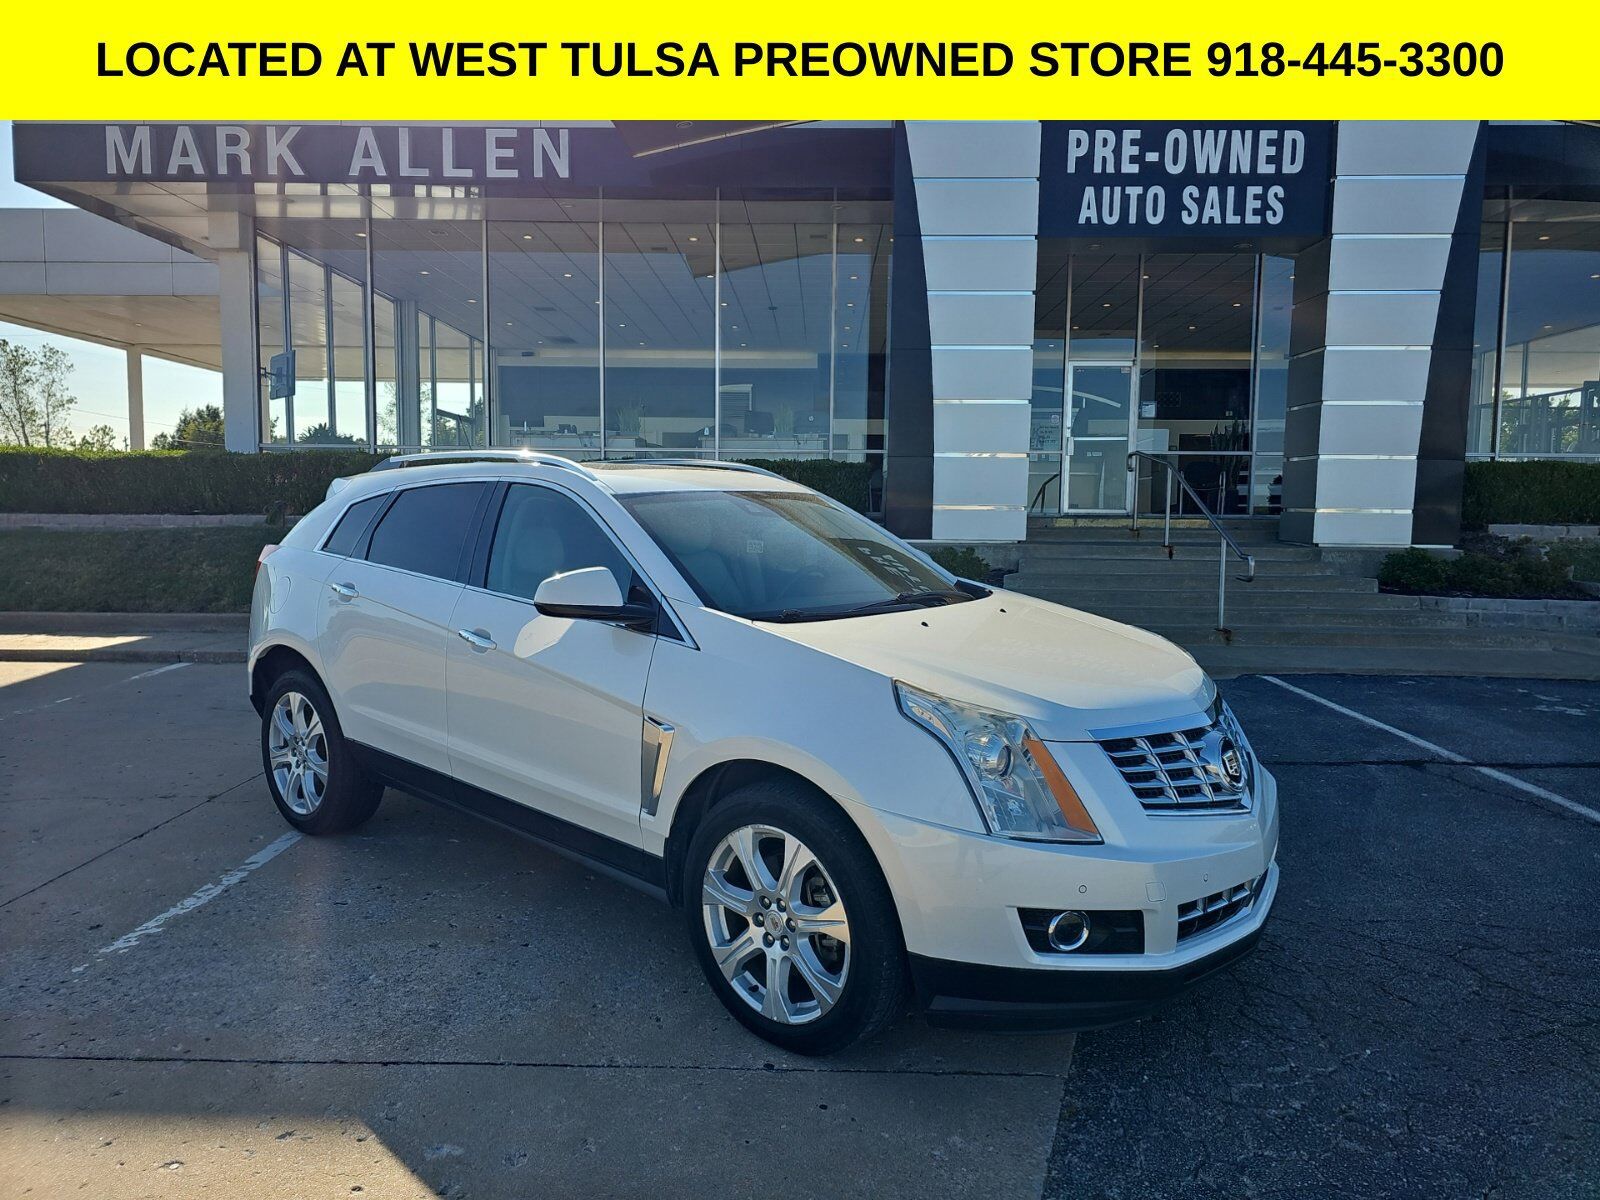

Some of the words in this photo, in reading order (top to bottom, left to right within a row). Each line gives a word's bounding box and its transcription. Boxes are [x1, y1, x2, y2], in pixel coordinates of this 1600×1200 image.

[105, 125, 305, 176] MARK
[348, 126, 569, 178] ALLEN
[1066, 128, 1306, 175] PRE-OWNED
[1077, 185, 1166, 225] AUTO
[1181, 185, 1285, 225] SALES
